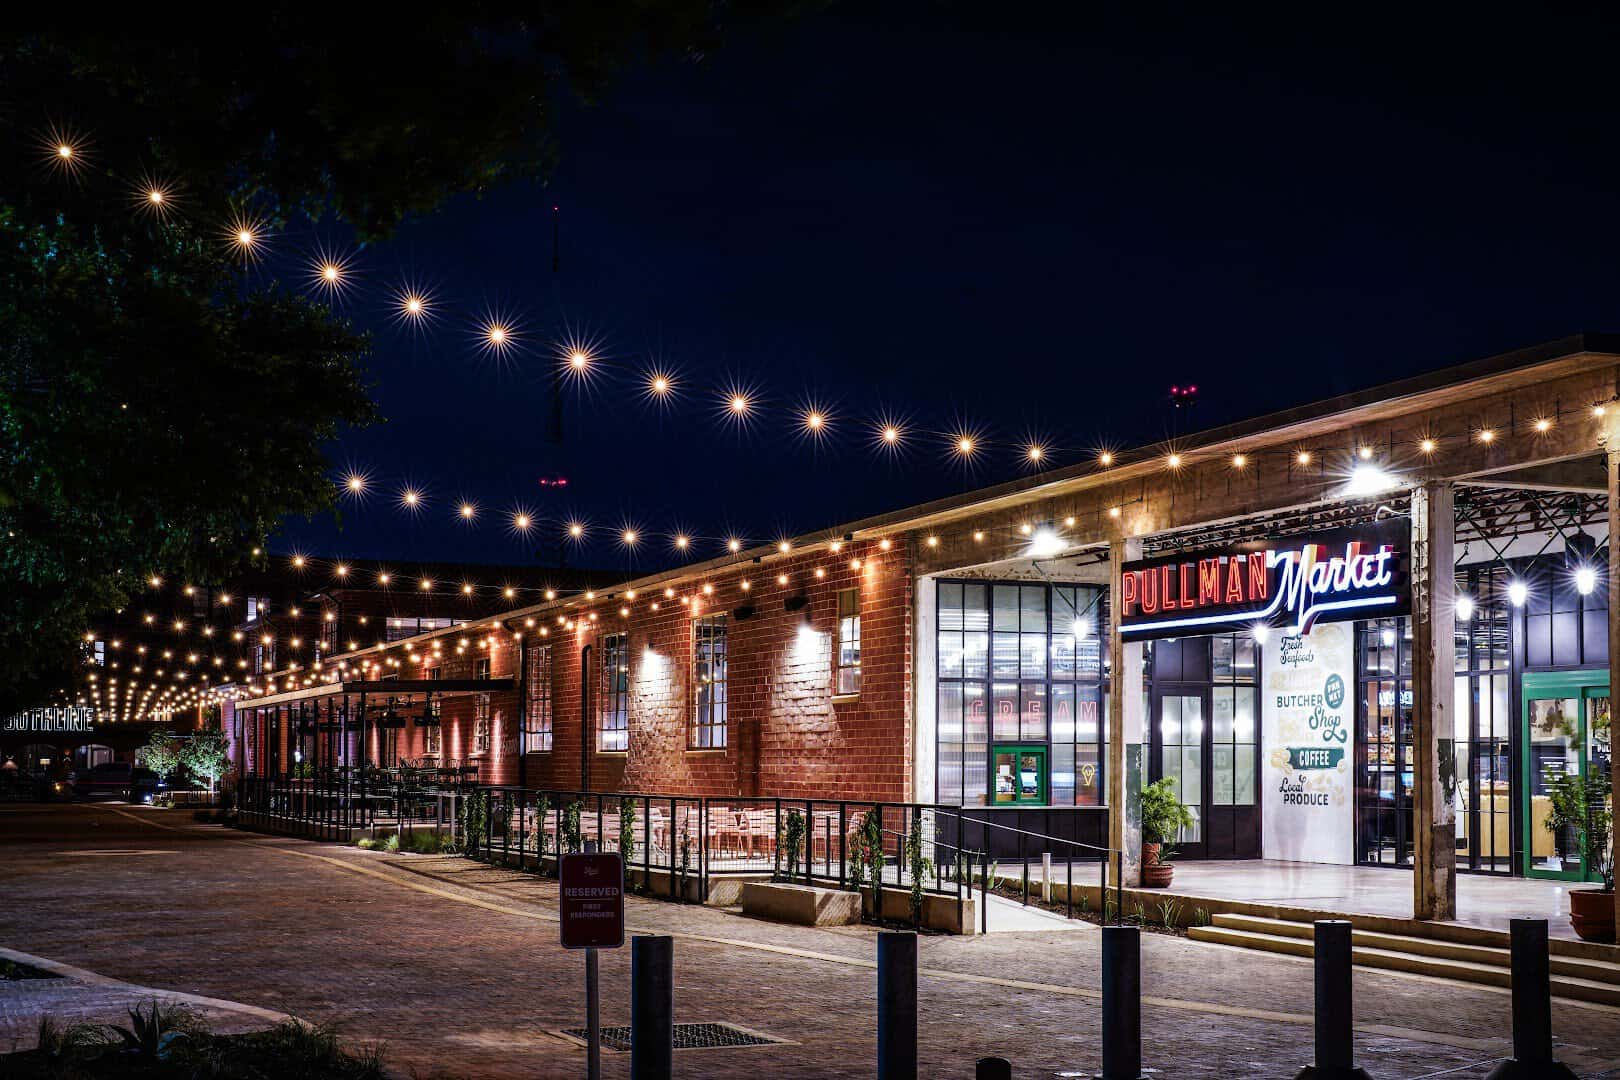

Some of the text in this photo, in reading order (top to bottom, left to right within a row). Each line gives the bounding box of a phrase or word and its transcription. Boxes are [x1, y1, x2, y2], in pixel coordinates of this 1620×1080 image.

[1122, 542, 1394, 616] PULLMAN Market
[1280, 634, 1303, 651] Fresh
[1276, 694, 1323, 708] BUTCHER
[970, 699, 1097, 723] CREAM
[1308, 705, 1348, 744] Shop
[1299, 750, 1330, 766] COFFEE
[1279, 774, 1307, 793] Local
[1283, 793, 1329, 806] PRODUCE
[564, 887, 620, 897] RESERVED
